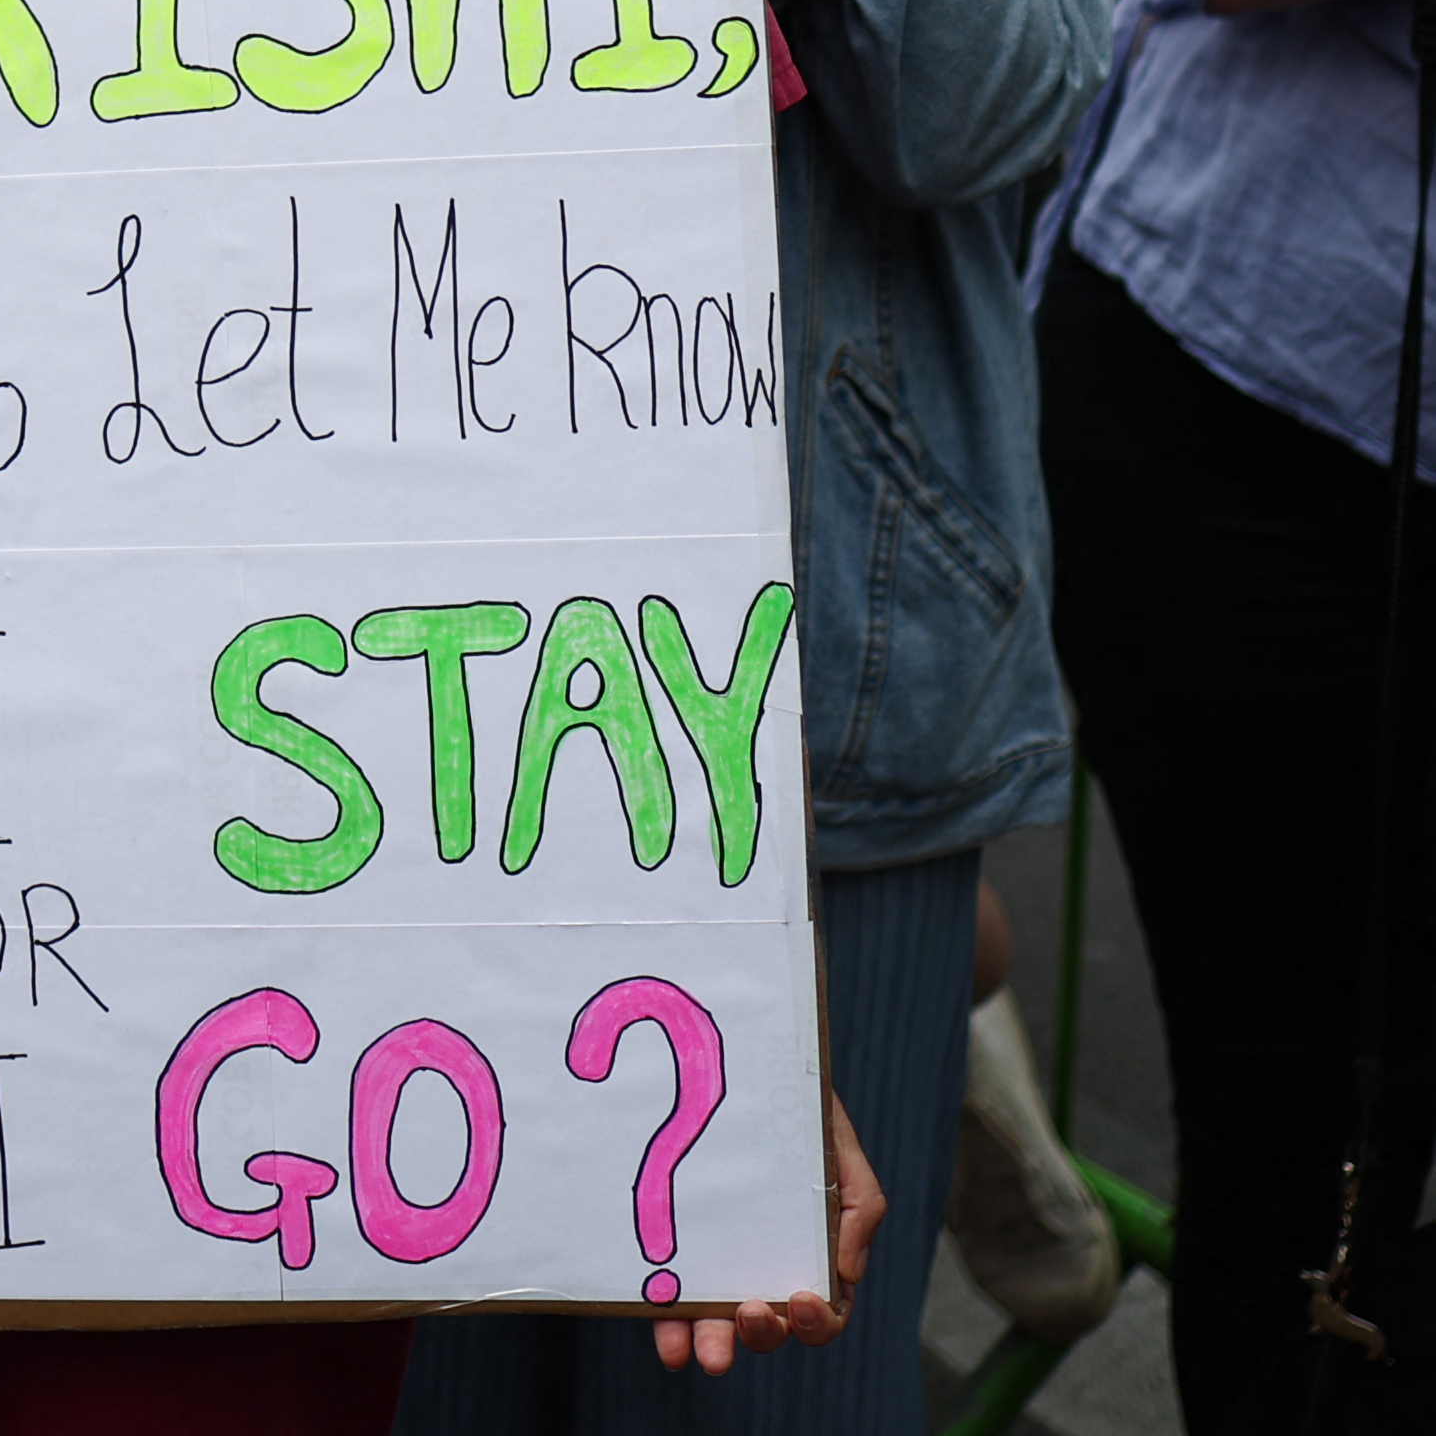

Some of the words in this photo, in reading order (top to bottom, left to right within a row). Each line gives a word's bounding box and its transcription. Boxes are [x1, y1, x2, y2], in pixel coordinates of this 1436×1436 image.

[87, 196, 334, 464] Let
[391, 198, 515, 442] Me
[211, 579, 797, 895] STAY
